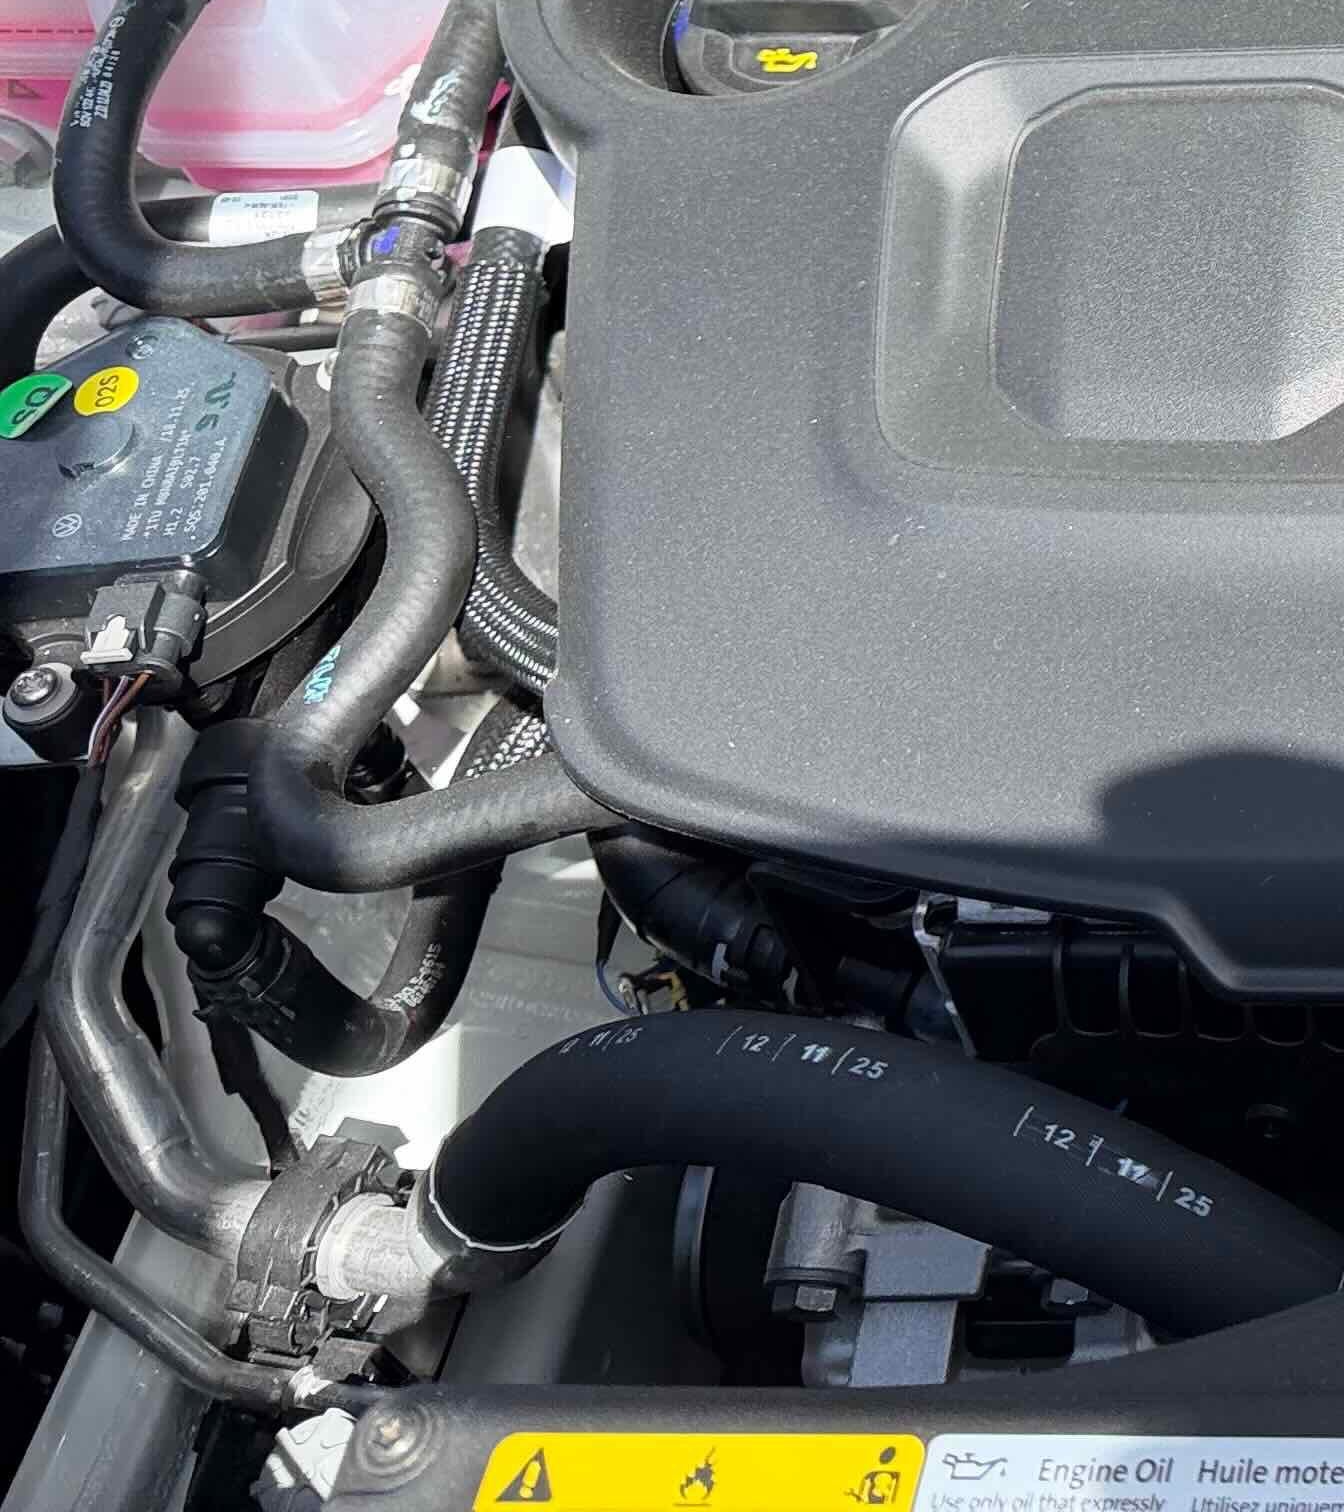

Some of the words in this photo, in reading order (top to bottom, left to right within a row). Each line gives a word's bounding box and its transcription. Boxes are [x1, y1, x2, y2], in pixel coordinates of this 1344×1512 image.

[1038, 1457, 1128, 1490] Engine
[1135, 1457, 1174, 1484] Oil
[1196, 1458, 1269, 1485] Huile
[930, 1492, 963, 1512] Use
[969, 1492, 1005, 1512] only
[1012, 1492, 1034, 1512] oil
[1039, 1492, 1076, 1512] that
[1081, 1492, 1166, 1512] expressly
[1191, 1496, 1260, 1512] Utilisez
